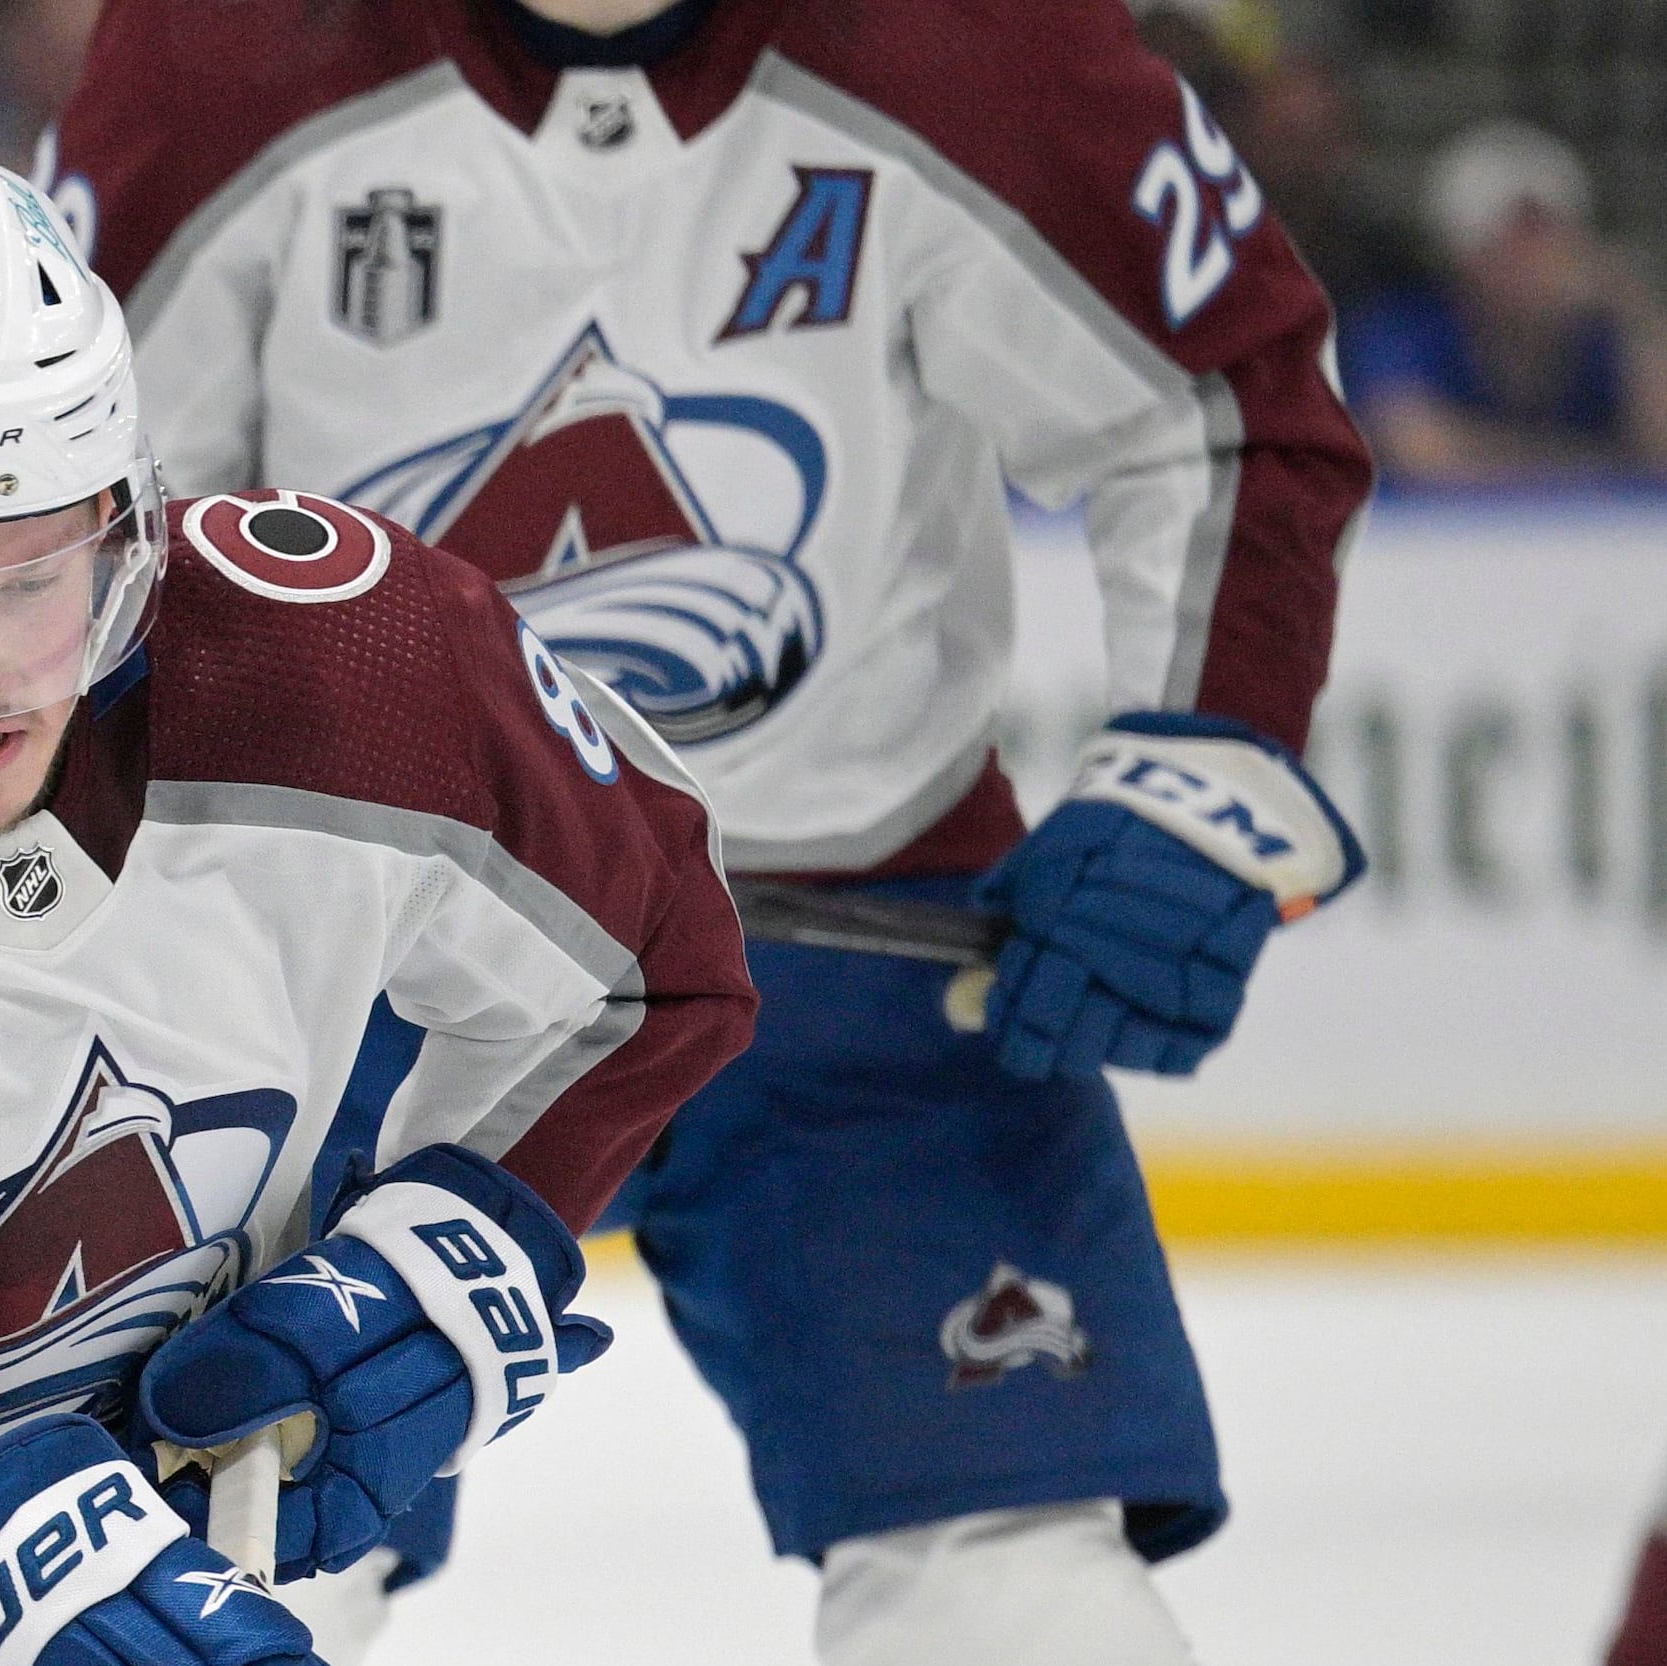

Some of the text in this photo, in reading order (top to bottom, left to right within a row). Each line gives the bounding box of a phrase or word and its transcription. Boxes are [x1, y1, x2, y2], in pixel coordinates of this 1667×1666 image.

[711, 163, 876, 345] A
[1132, 68, 1264, 332] 29
[15, 864, 48, 911] NHL
[409, 1218, 549, 1446] BAU
